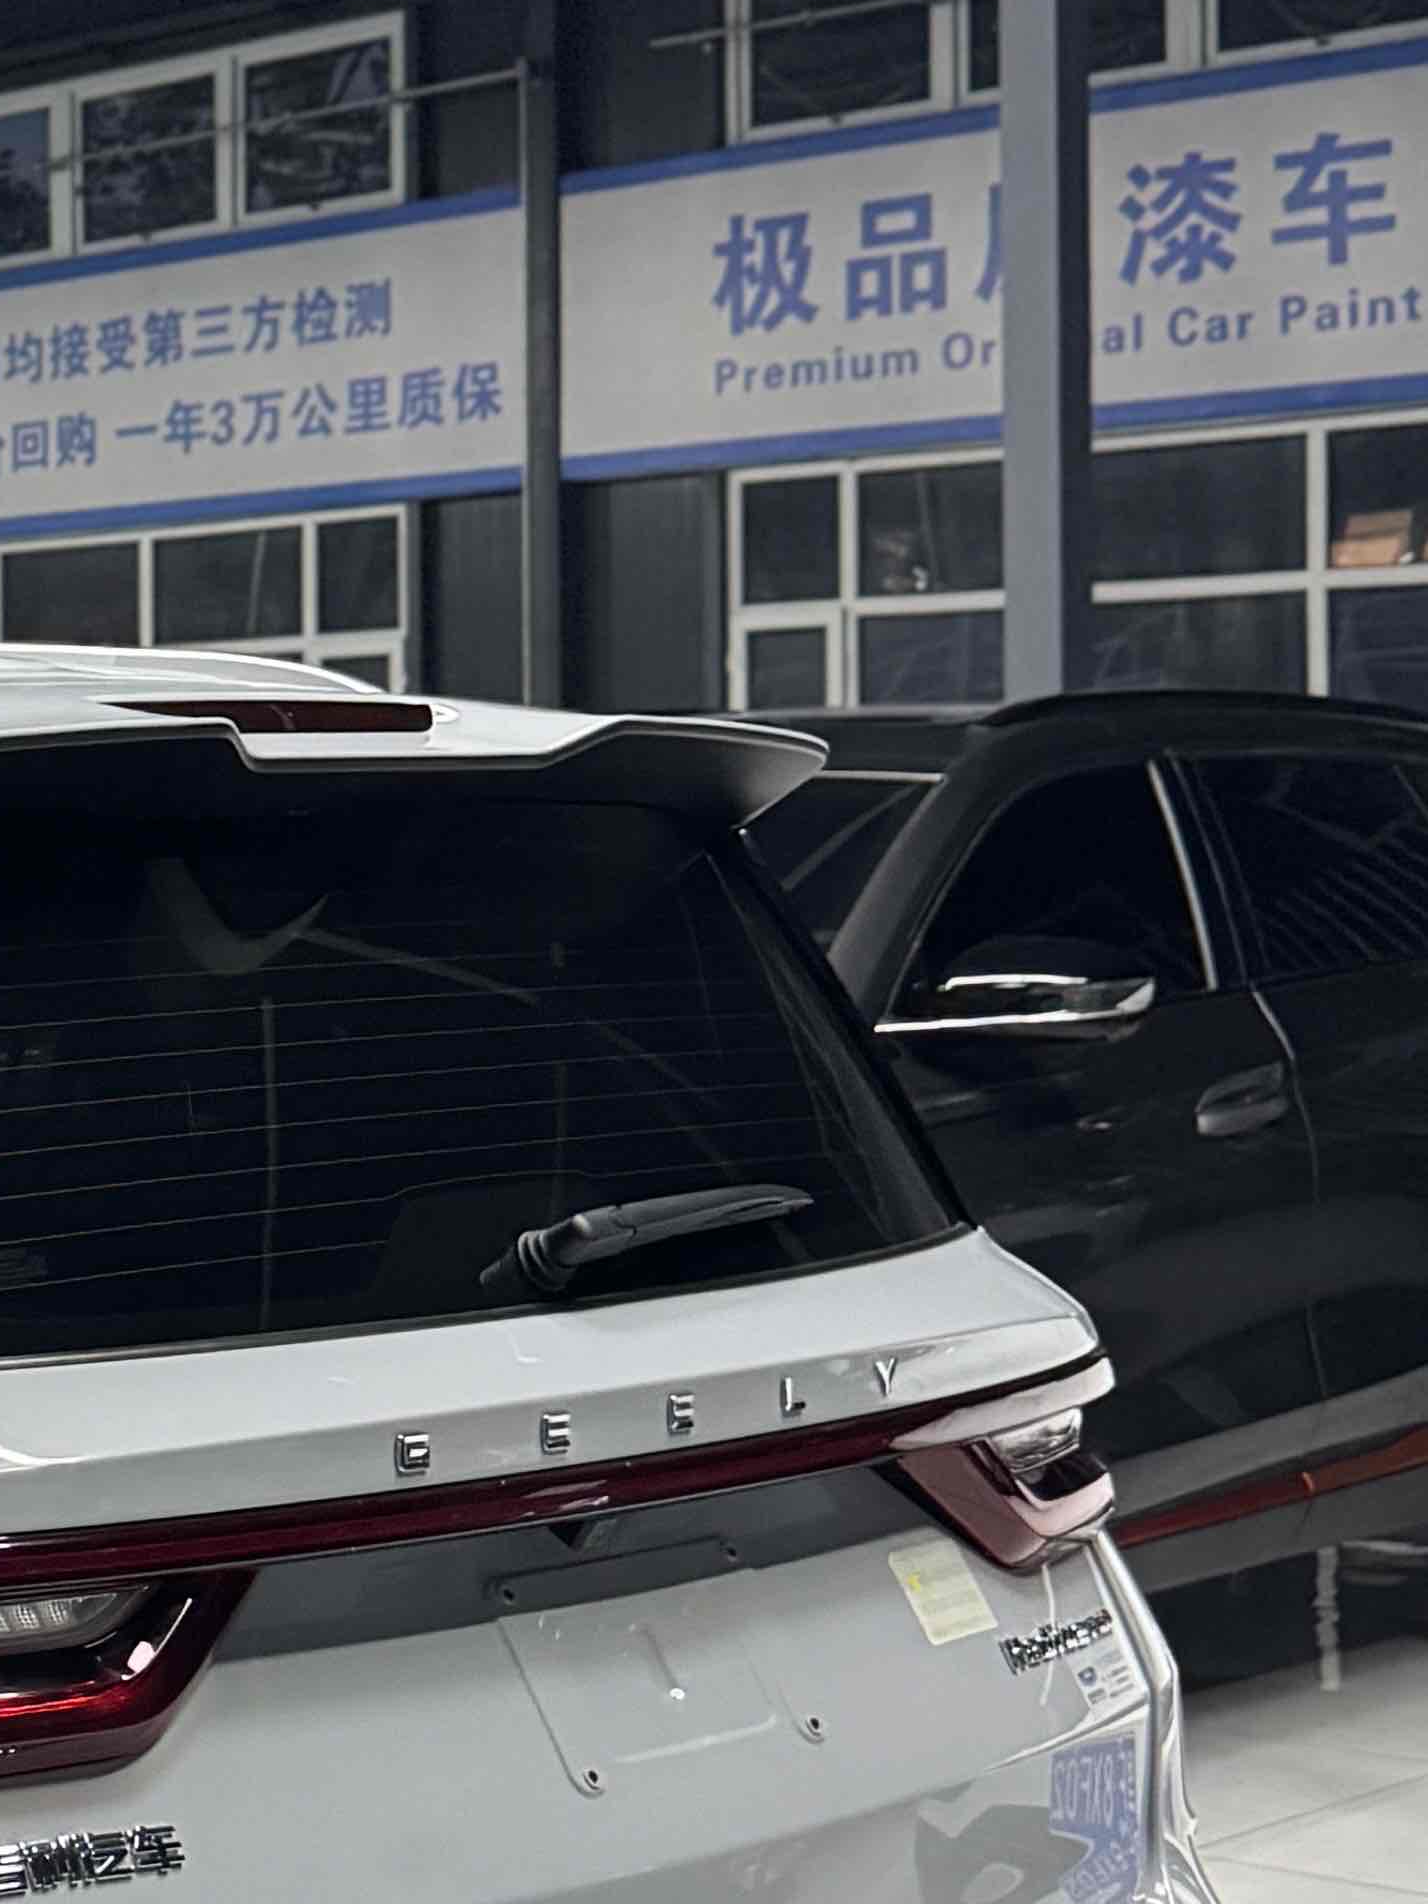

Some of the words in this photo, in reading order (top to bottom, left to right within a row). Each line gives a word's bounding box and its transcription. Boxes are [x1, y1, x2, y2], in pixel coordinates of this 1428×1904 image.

[712, 132, 1398, 337] 极品漆车
[716, 339, 919, 395] Premium
[944, 315, 1145, 370] Oral
[1168, 307, 1255, 347] Car
[1279, 286, 1422, 336] Paint
[115, 360, 504, 457] 一年3万公里质保
[393, 1356, 897, 1477] GEELY
